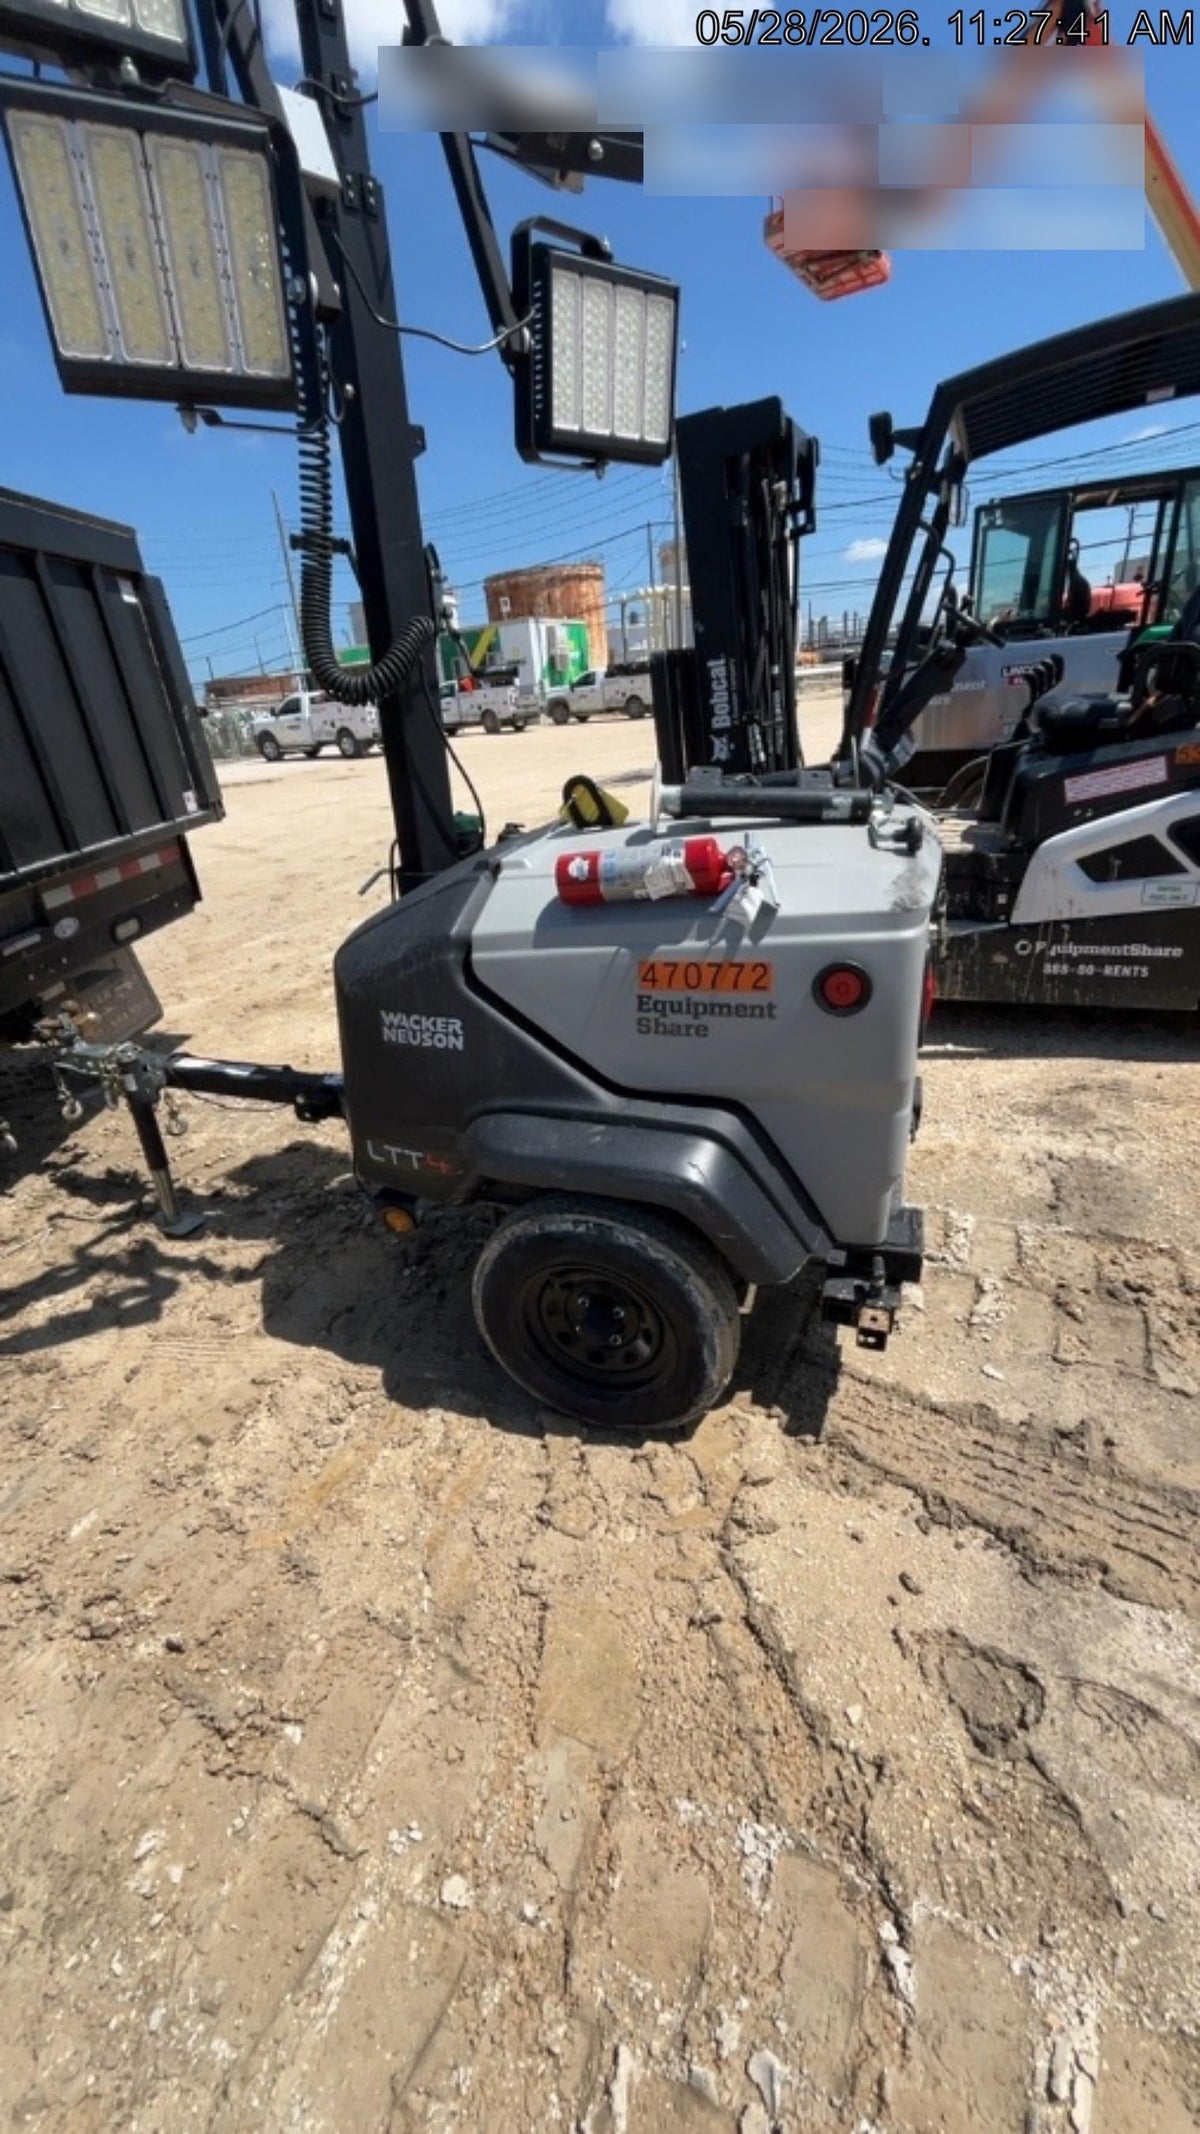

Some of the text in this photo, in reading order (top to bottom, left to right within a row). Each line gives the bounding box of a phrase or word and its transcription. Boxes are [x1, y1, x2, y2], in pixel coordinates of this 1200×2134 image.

[706, 655, 732, 729] Bobcat
[641, 961, 769, 990] 470772
[636, 995, 777, 1020] Equipment
[380, 1009, 464, 1035] WACKER
[637, 1016, 710, 1038] Share
[382, 1026, 464, 1051] NEUSON
[366, 1139, 453, 1175] LTT4
